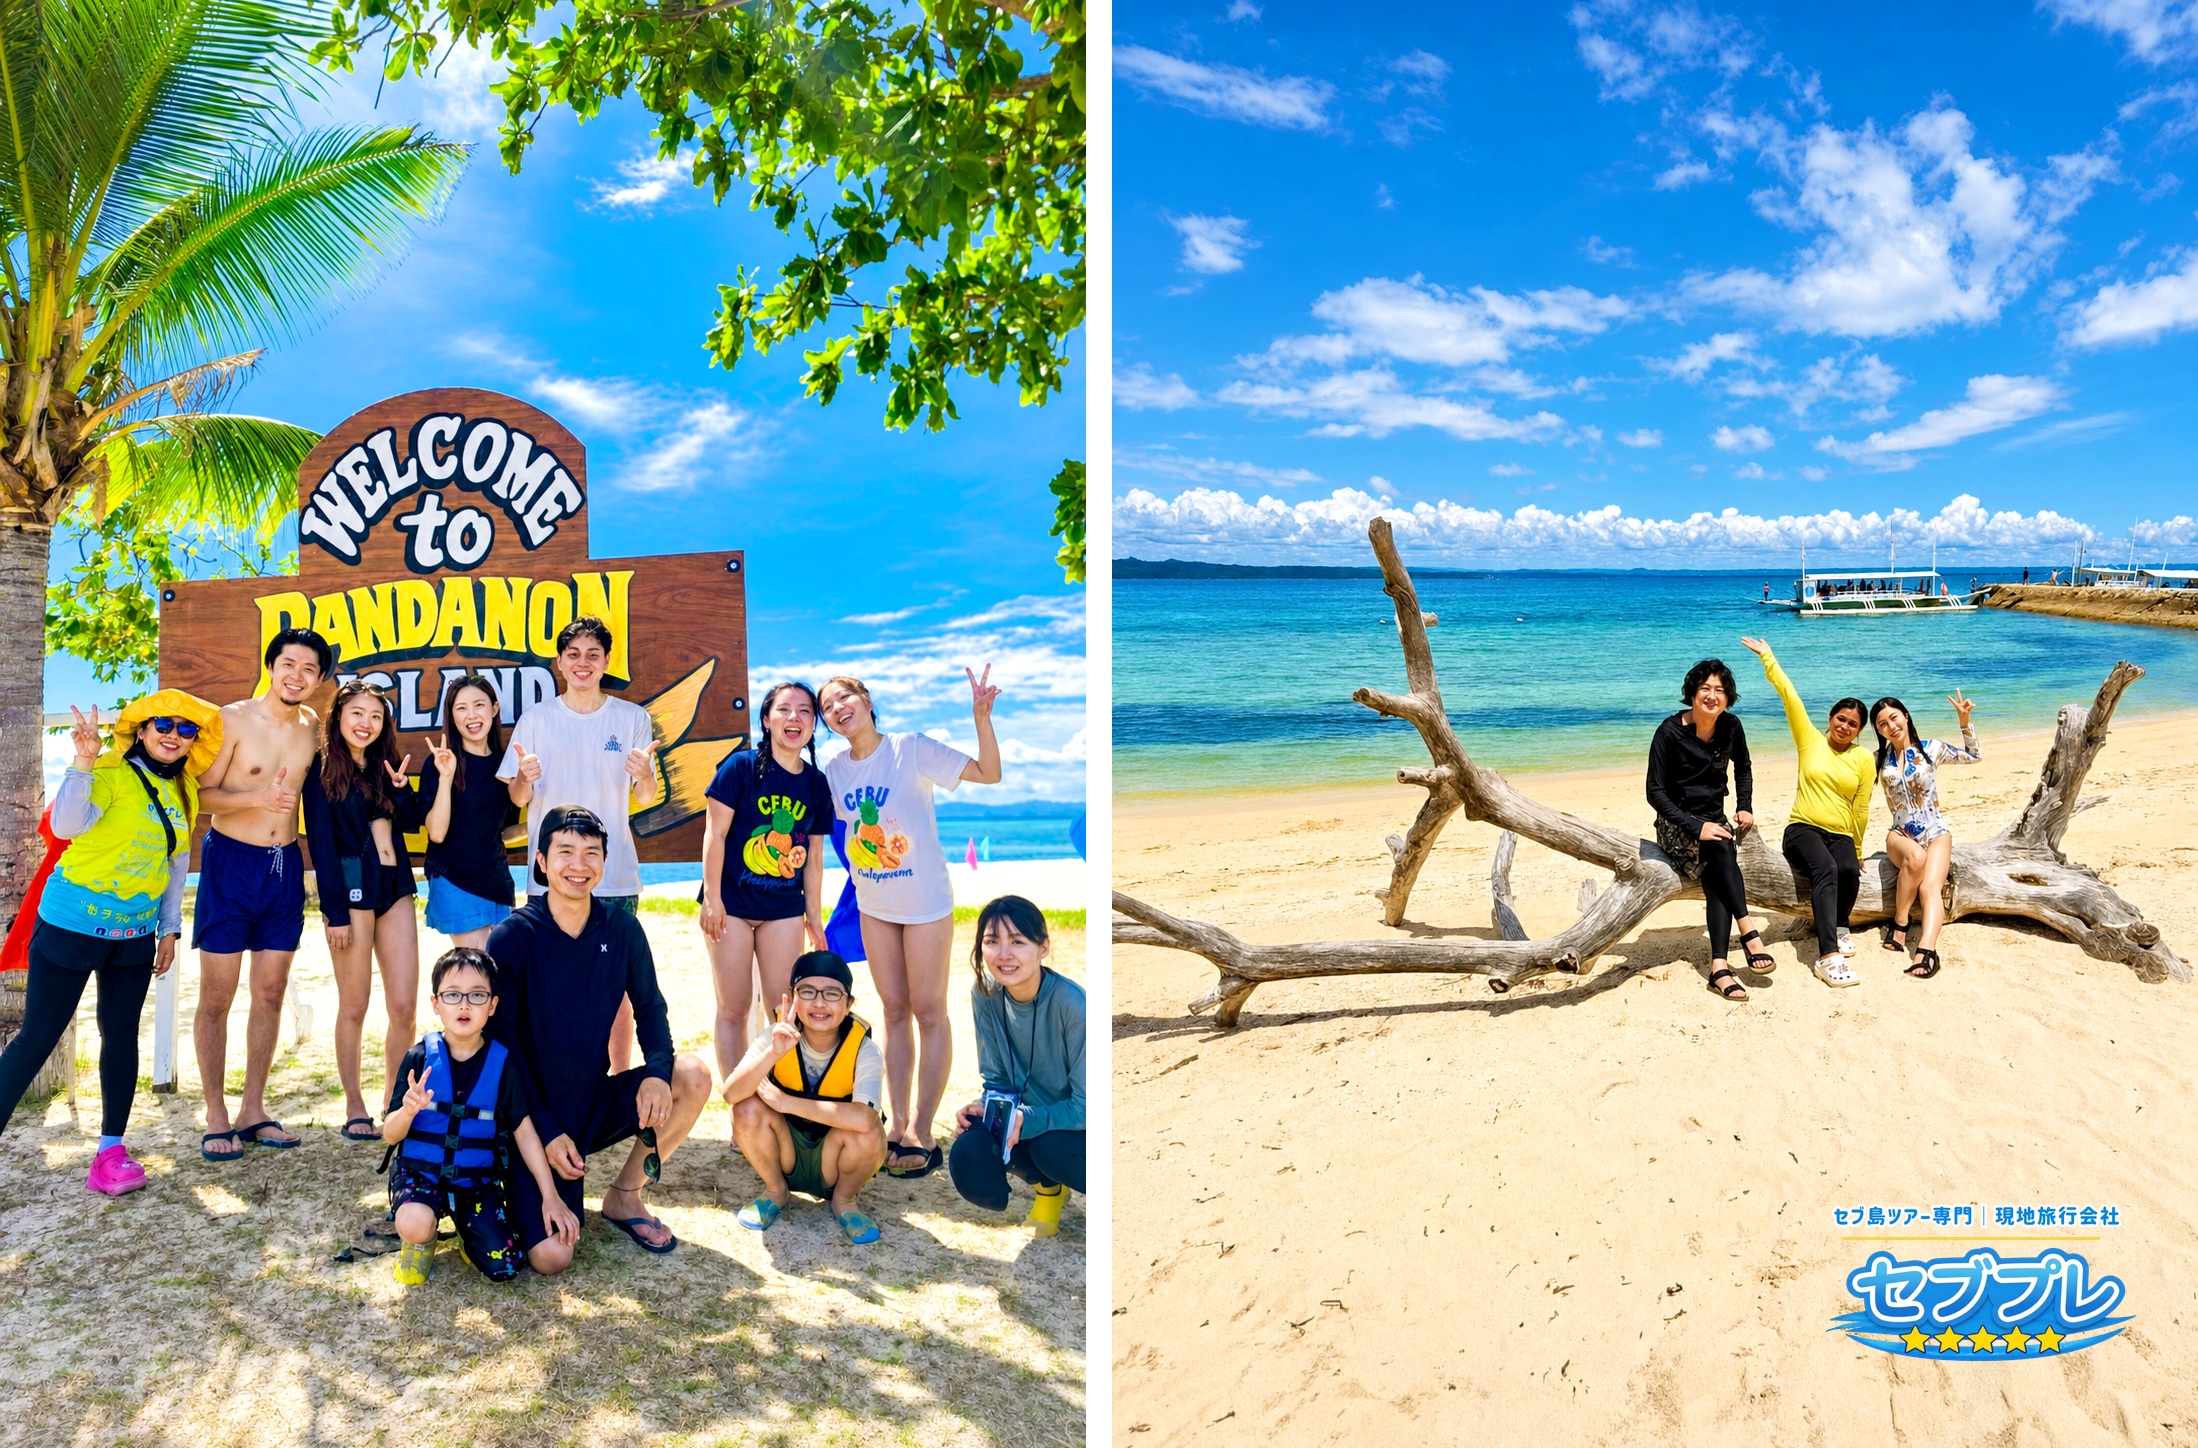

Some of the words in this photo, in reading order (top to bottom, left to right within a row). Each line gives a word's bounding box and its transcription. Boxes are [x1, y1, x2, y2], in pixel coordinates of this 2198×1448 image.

[301, 414, 585, 559] WELCOME
[400, 492, 493, 568] to
[336, 665, 556, 729] SLND
[757, 794, 807, 821] CEBU
[844, 785, 890, 812] CEBU
